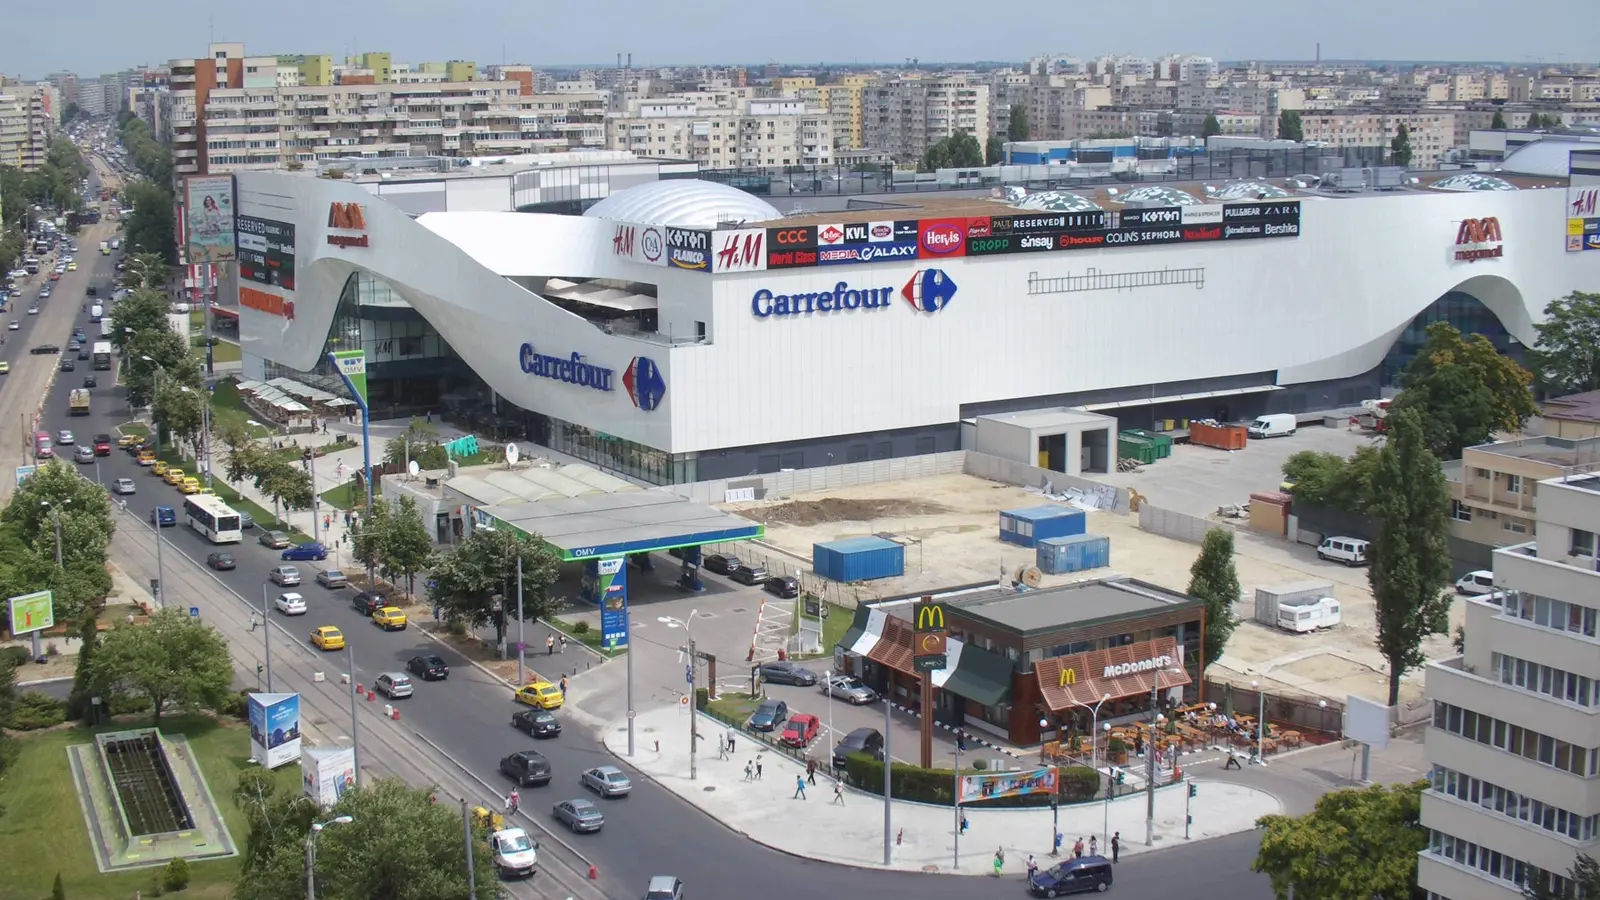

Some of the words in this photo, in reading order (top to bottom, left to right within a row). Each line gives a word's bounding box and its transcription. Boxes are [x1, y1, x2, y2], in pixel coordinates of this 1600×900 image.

[1572, 190, 1598, 215] H&M
[1225, 208, 1260, 217] PULL&BEAR
[1264, 206, 1298, 215] ZARA
[993, 220, 1011, 228] PAUL
[1013, 218, 1060, 228] RESERVED
[1265, 224, 1298, 234] Bershka
[777, 230, 807, 243] CCC
[846, 227, 867, 240] KVL
[927, 231, 959, 246] Hervis
[1106, 232, 1139, 243] COLIN'S
[1141, 231, 1181, 240] SEPHORA
[612, 225, 635, 258] H&M
[972, 239, 1009, 251] CROPP
[1021, 236, 1053, 249] sinsay
[673, 249, 704, 263] FLANCO
[718, 233, 763, 268] H&M
[820, 249, 859, 260] MEDIA
[861, 245, 917, 260] GALAXY
[752, 281, 894, 318] Carrefour
[519, 342, 613, 391] Carrefour
[575, 548, 596, 557] OMV
[1104, 655, 1171, 678] McDonald's
